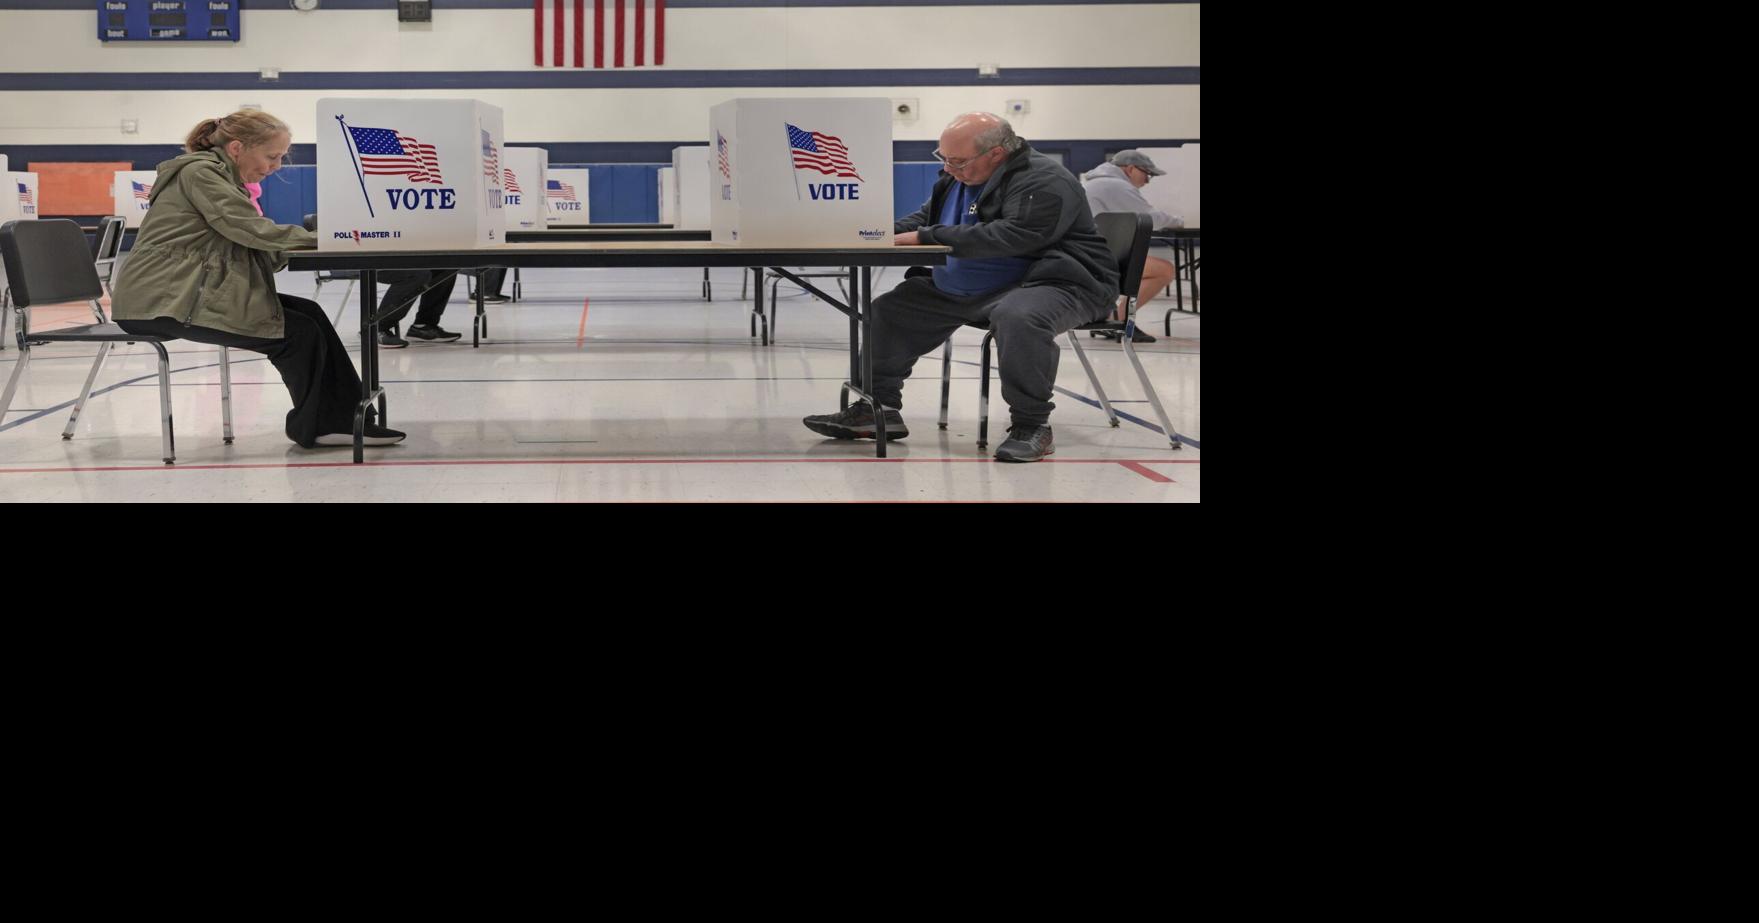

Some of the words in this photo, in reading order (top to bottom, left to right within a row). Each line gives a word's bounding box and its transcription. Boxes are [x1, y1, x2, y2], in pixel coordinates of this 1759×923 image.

[152, 1, 180, 10] player
[809, 183, 859, 200] VOTE
[386, 188, 456, 210] VOTE
[555, 202, 581, 210] VOTE
